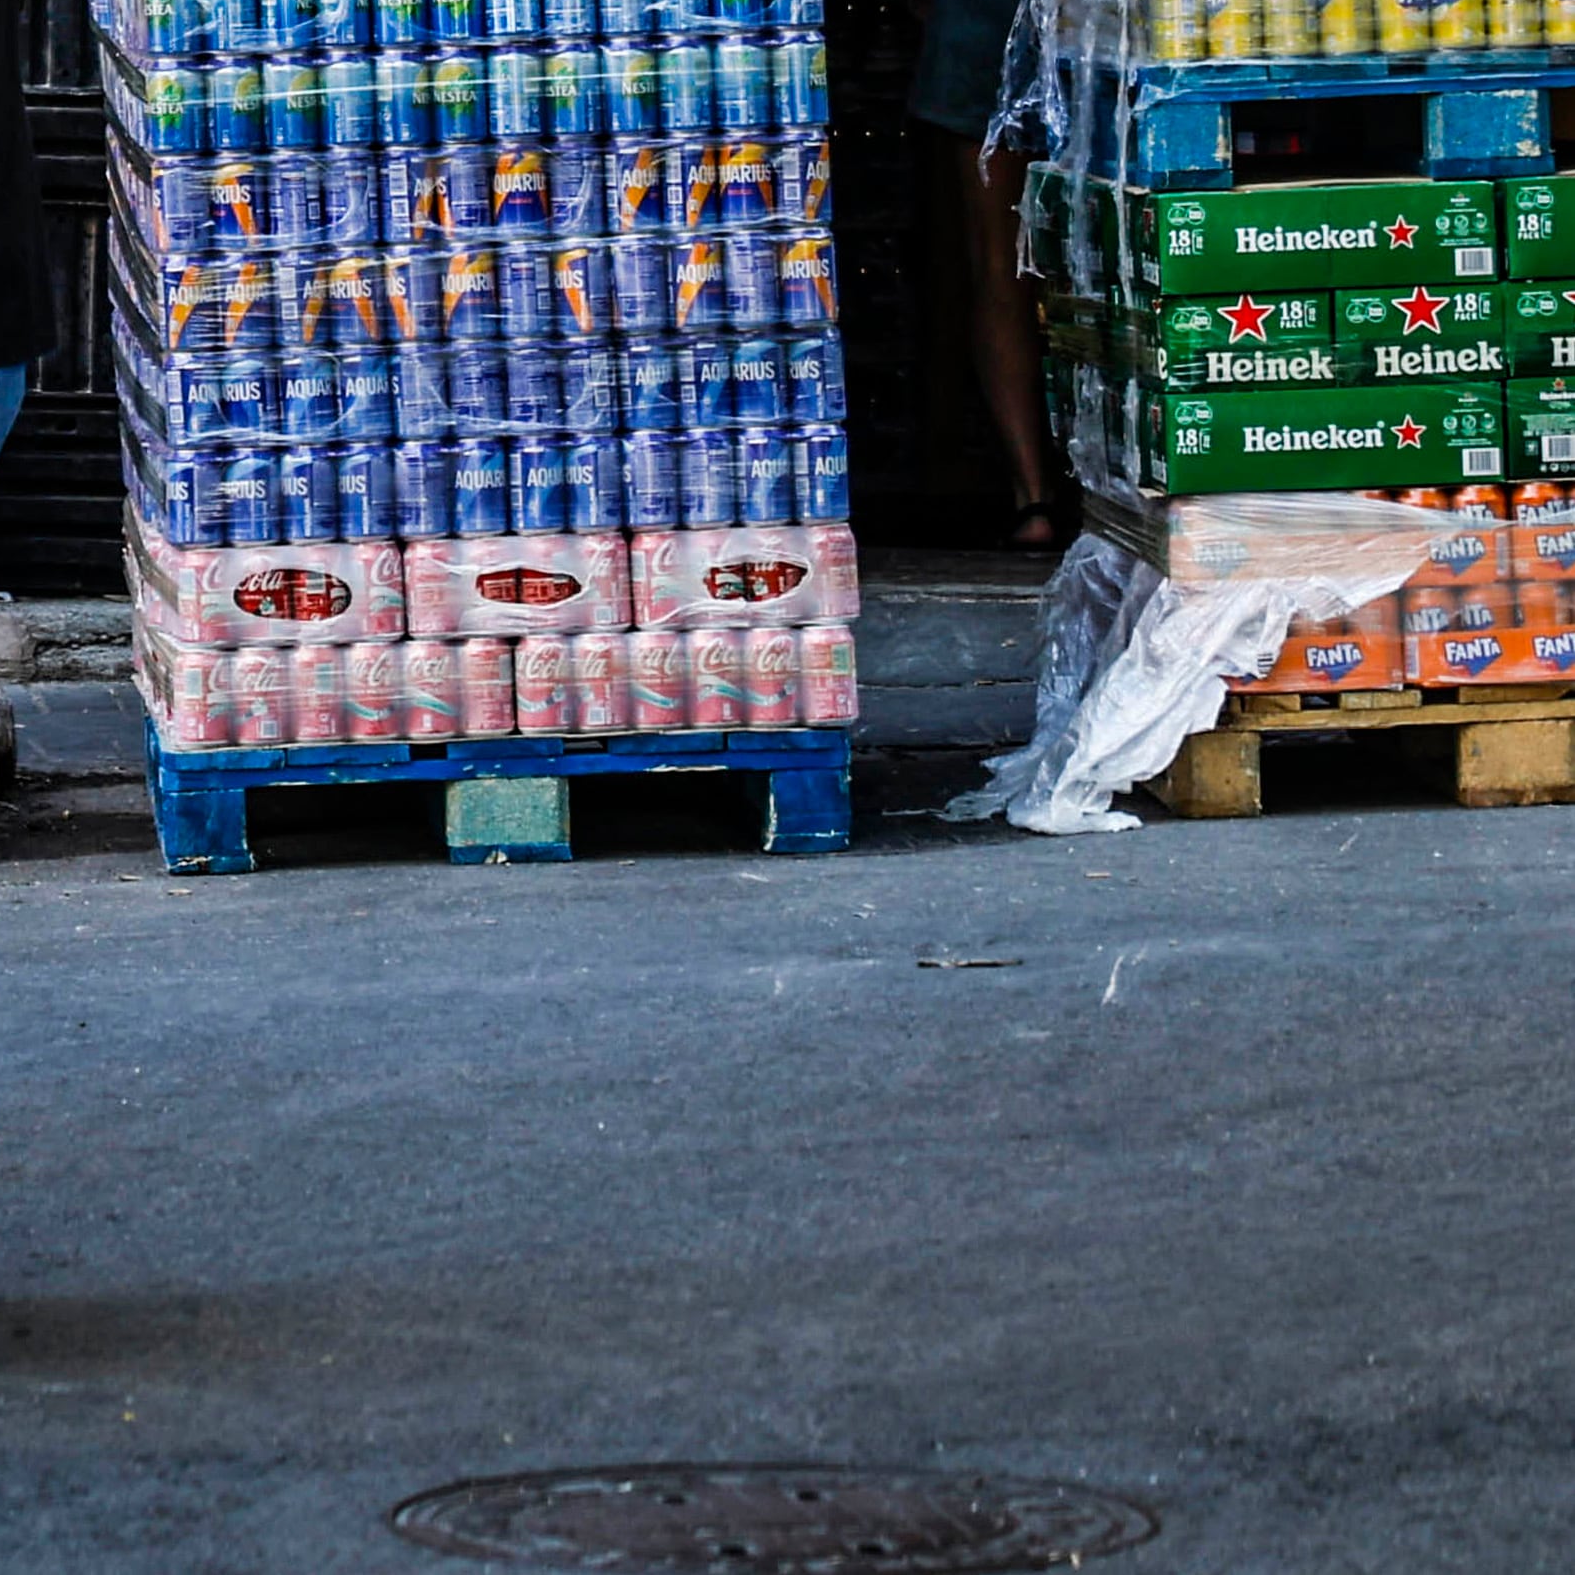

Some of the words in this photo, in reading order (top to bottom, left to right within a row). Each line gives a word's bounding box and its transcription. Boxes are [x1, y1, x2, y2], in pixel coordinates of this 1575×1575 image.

[1517, 214, 1539, 232] 18
[1169, 229, 1191, 248] 18
[1235, 221, 1378, 254] Heineken
[1517, 231, 1540, 240] PACK
[1169, 247, 1191, 256] PACK
[1279, 300, 1303, 321] 18
[1453, 293, 1477, 312] 18
[1280, 320, 1303, 329] PACK
[1454, 311, 1478, 321] PACK
[1206, 348, 1334, 383] Heinek
[1374, 340, 1502, 376] Heinek
[1176, 429, 1198, 446] 18
[1243, 423, 1384, 452] Heineken
[1429, 536, 1485, 561] FANTA
[1306, 642, 1363, 668] FANTA
[1444, 636, 1501, 663] FANTA
